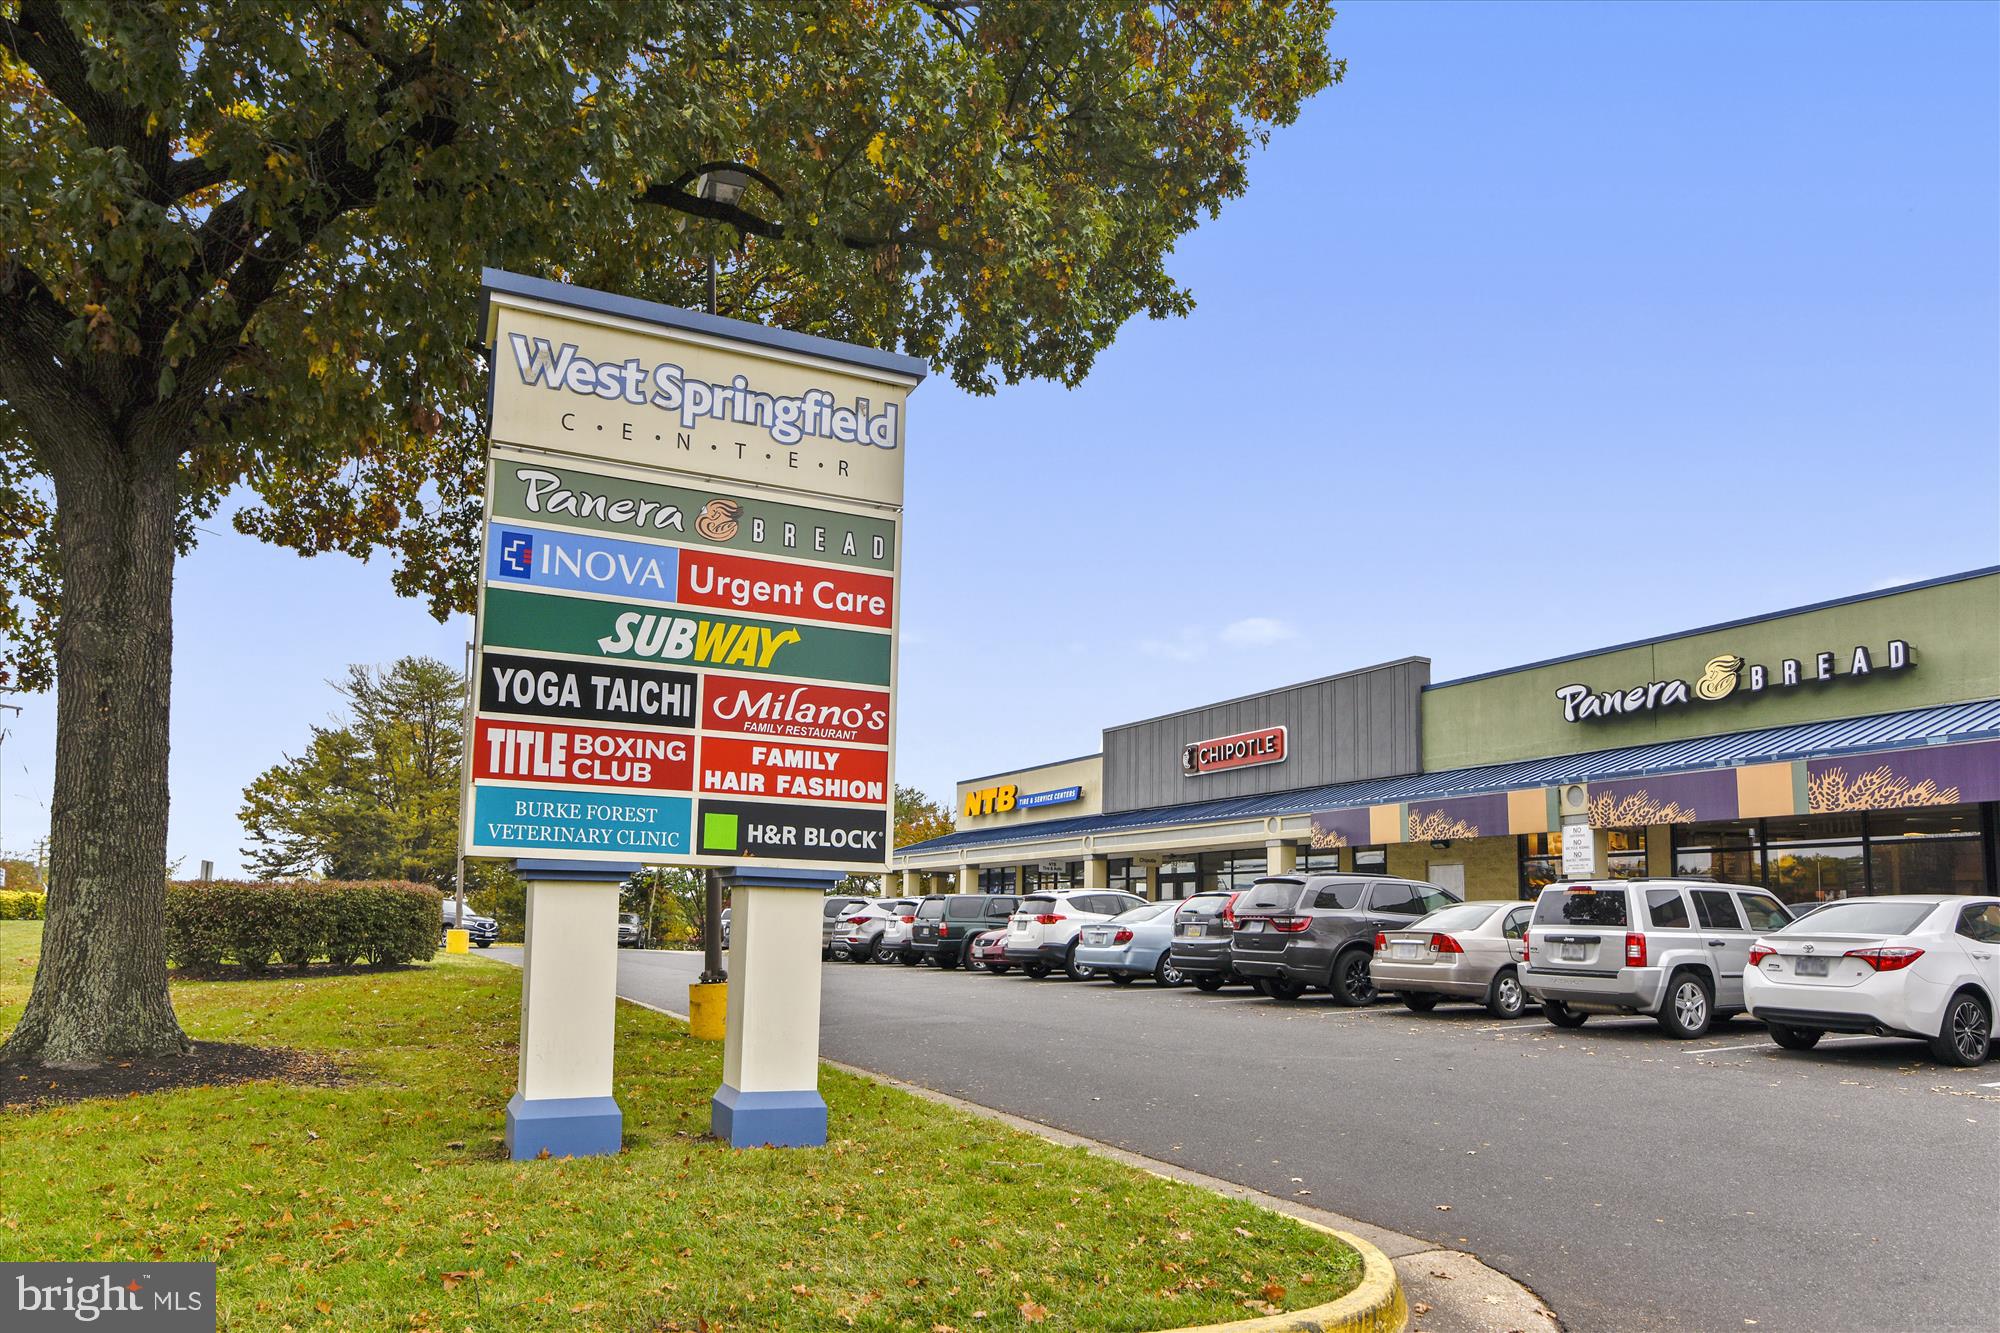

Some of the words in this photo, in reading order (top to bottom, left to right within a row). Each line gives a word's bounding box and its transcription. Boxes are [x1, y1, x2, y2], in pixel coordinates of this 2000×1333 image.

[508, 332, 648, 405] West
[652, 362, 898, 449] Springfield
[516, 469, 684, 533] Panera
[752, 517, 885, 560] BREAD
[541, 544, 665, 589] INOVA
[690, 564, 804, 605] Urgent
[813, 583, 887, 616] Care
[597, 611, 801, 668] SUBWAY
[492, 667, 581, 707] YOGA
[591, 675, 691, 717] TAICHI
[1556, 680, 1689, 721] Panera
[1751, 640, 1909, 691] BREAD
[713, 687, 886, 730] Milano's
[743, 721, 784, 735] FAMILY
[785, 724, 857, 740] RESTAURANT
[1199, 735, 1276, 764] CHIPOTLE
[487, 727, 567, 777] TITLE
[572, 735, 686, 762] BOXING
[572, 758, 652, 783] CLUB
[752, 746, 840, 770] FAMILY
[704, 770, 765, 793] HAIR
[777, 778, 883, 800] FASHION
[964, 784, 1018, 817] NTB
[1034, 793, 1053, 803] SERVICE
[1053, 789, 1076, 800] CENTERS
[515, 800, 581, 821] BURKE
[586, 804, 658, 824] FOREST
[488, 823, 613, 845] VETERINARY
[616, 827, 679, 848] CLINIC
[747, 823, 796, 845] H&R
